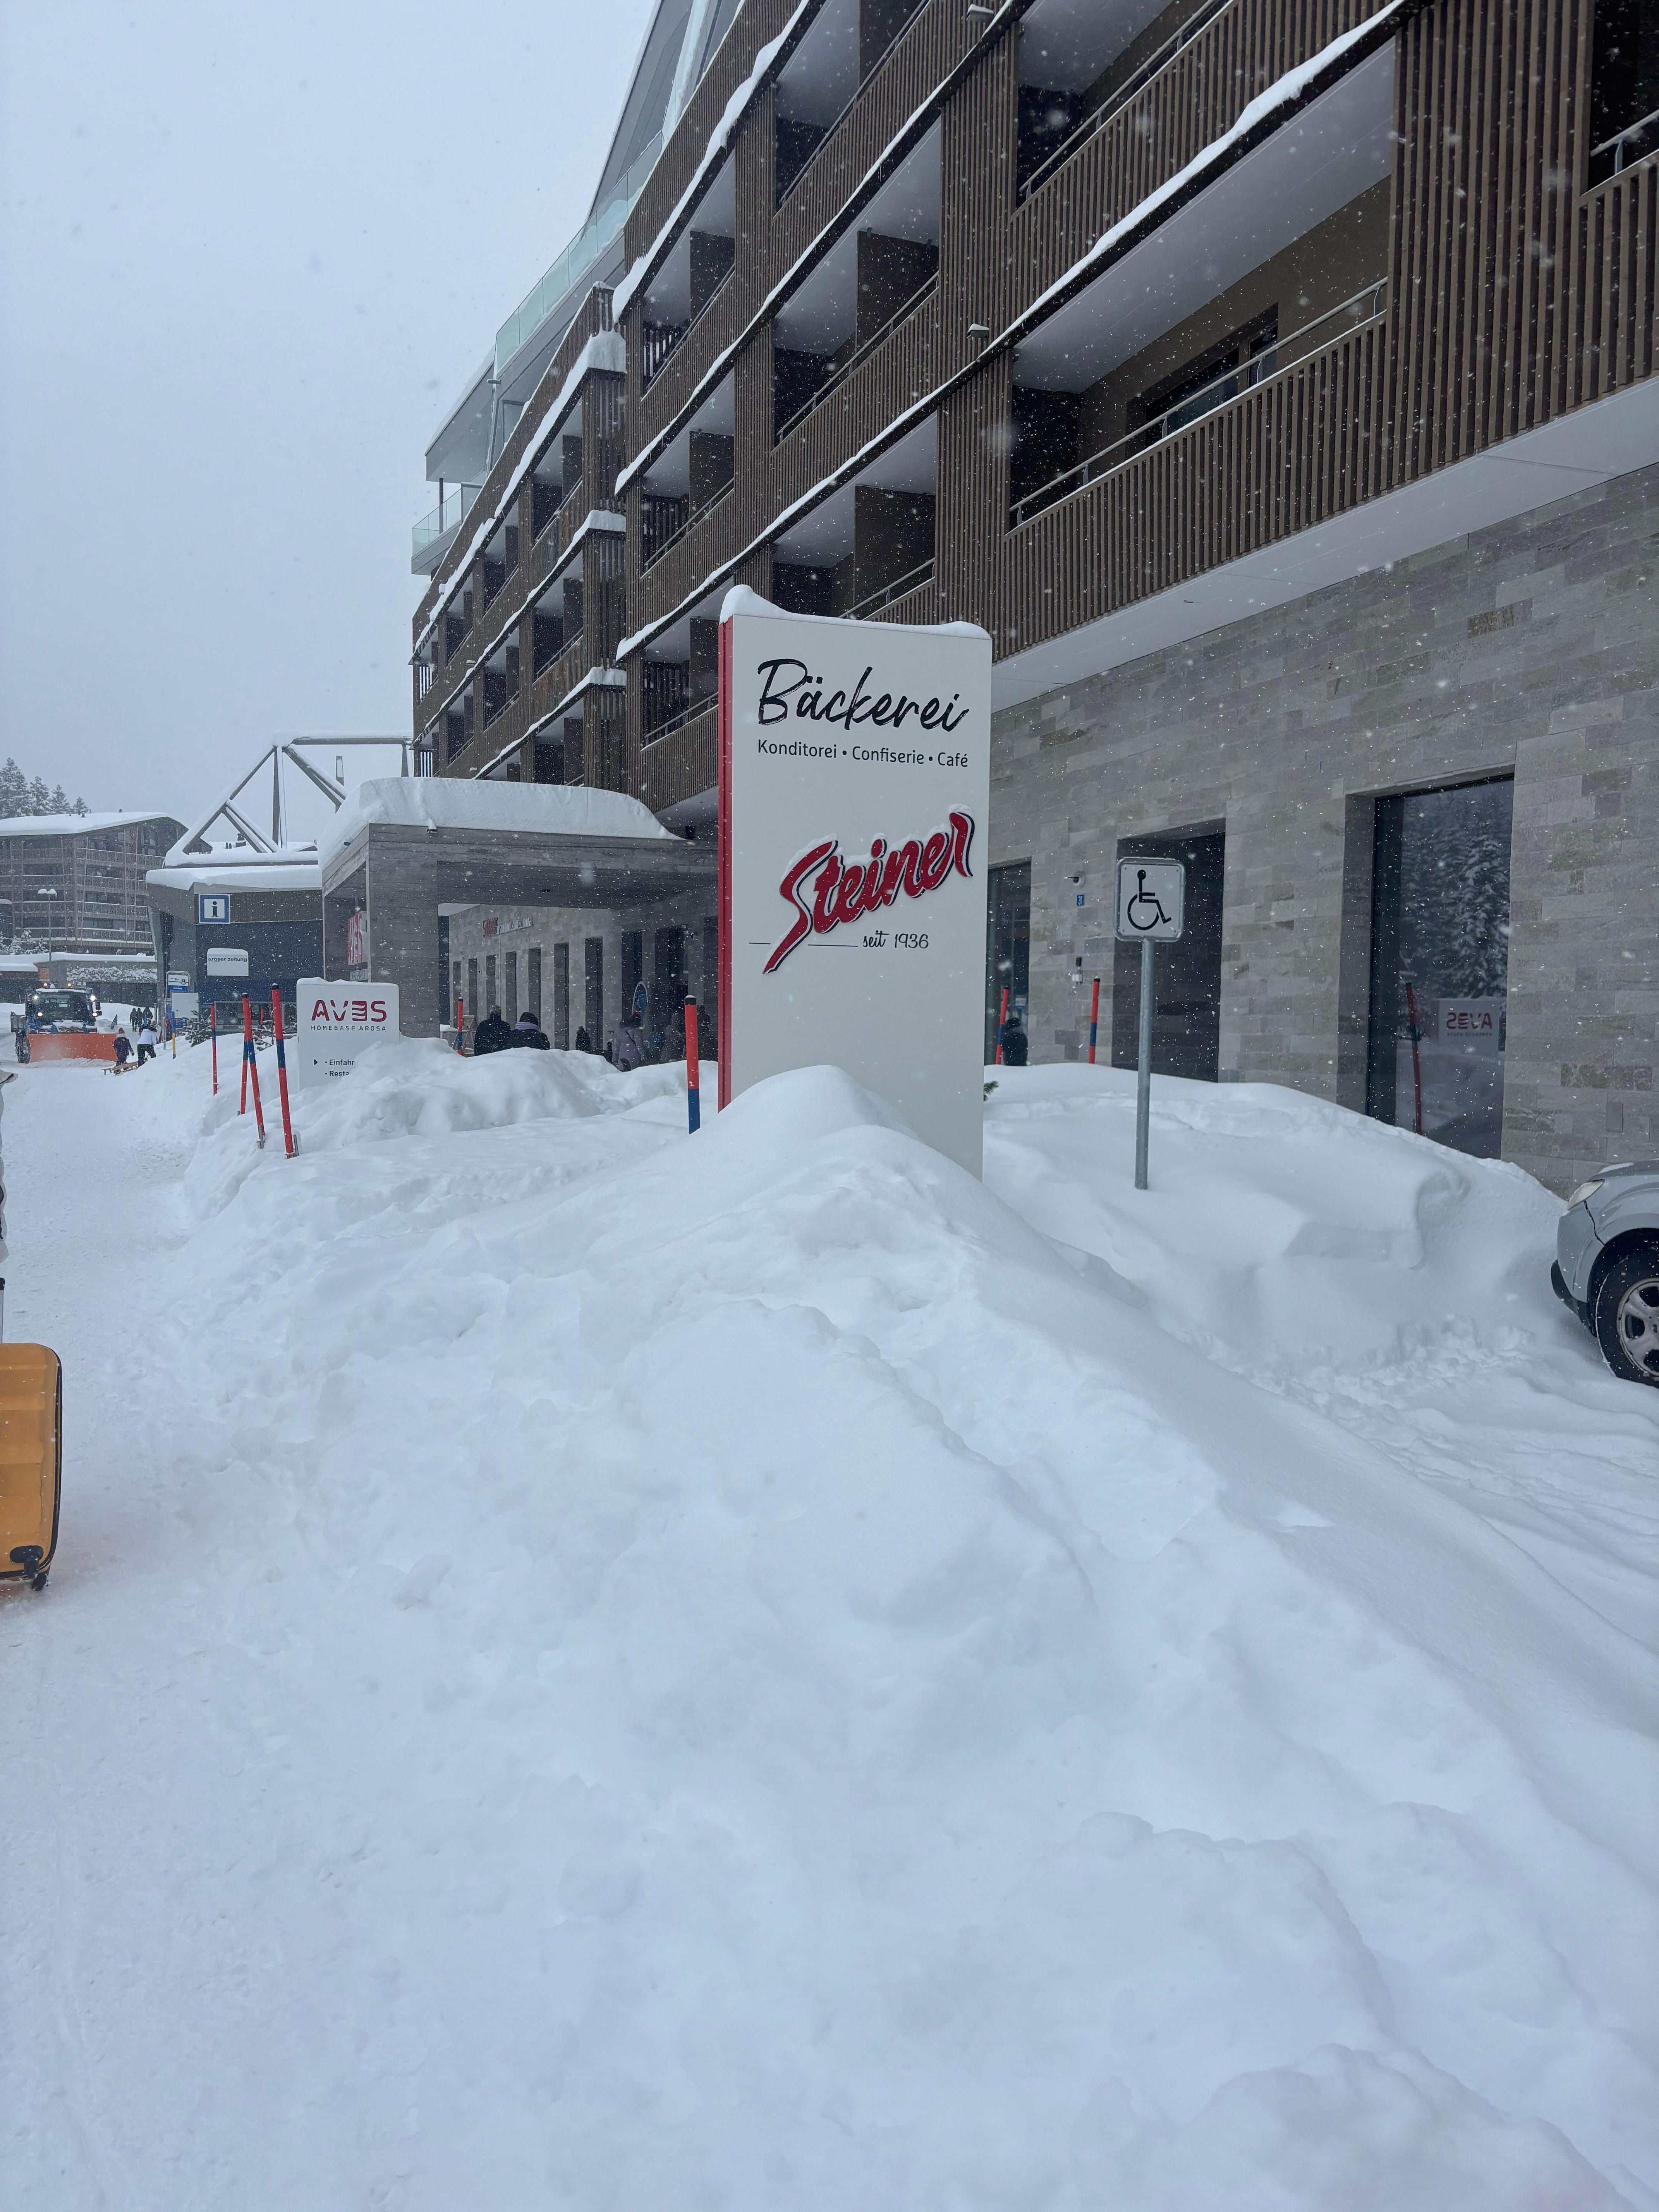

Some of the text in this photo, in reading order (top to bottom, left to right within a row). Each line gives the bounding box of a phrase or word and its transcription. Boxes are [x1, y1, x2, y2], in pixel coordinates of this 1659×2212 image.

[757, 658, 969, 732] Bäckerei
[758, 739, 968, 767] Konditorei Confiserie Café
[762, 812, 975, 974] Steiner
[1078, 895, 1083, 905] 31
[863, 930, 929, 949] seit 1936
[311, 1000, 387, 1022] AVES
